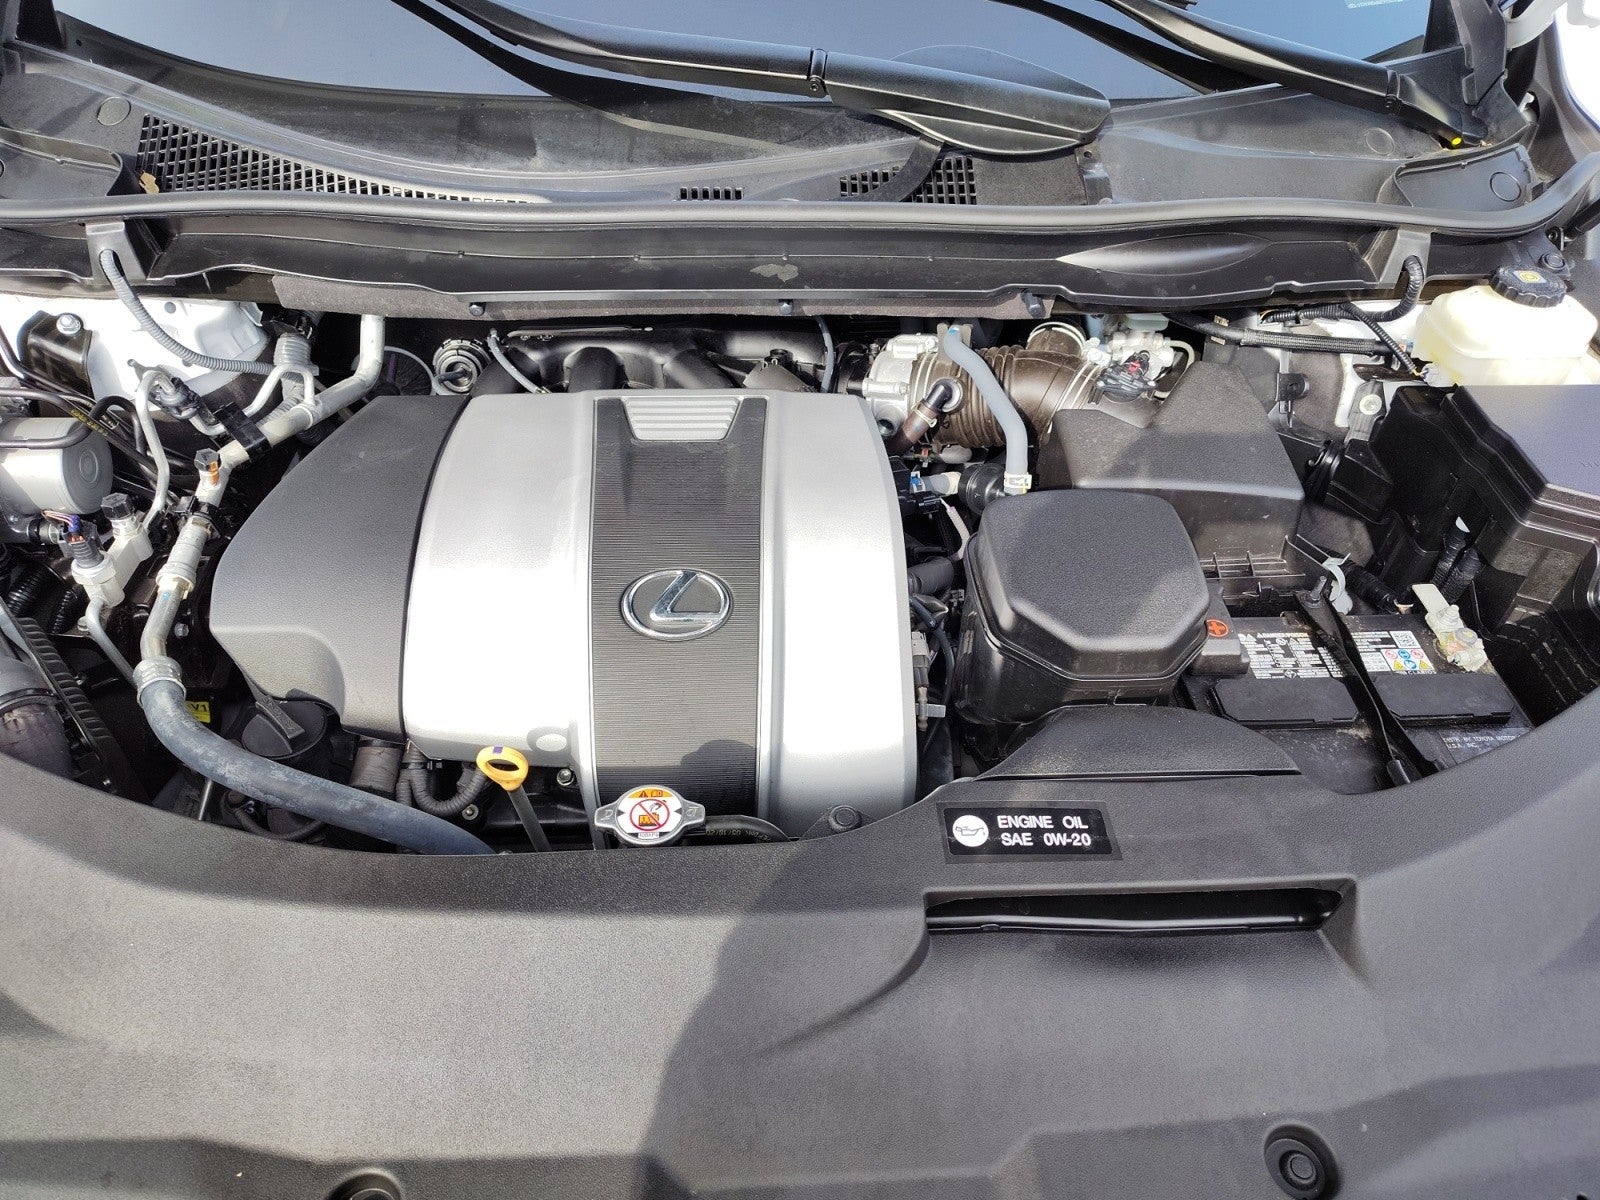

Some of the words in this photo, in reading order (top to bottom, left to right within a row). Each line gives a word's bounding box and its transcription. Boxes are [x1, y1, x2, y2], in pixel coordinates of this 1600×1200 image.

[997, 815, 1054, 829] ENGINE
[1062, 815, 1088, 829] OIL
[1001, 833, 1034, 846] SAE
[1043, 833, 1092, 846] 0W-20
